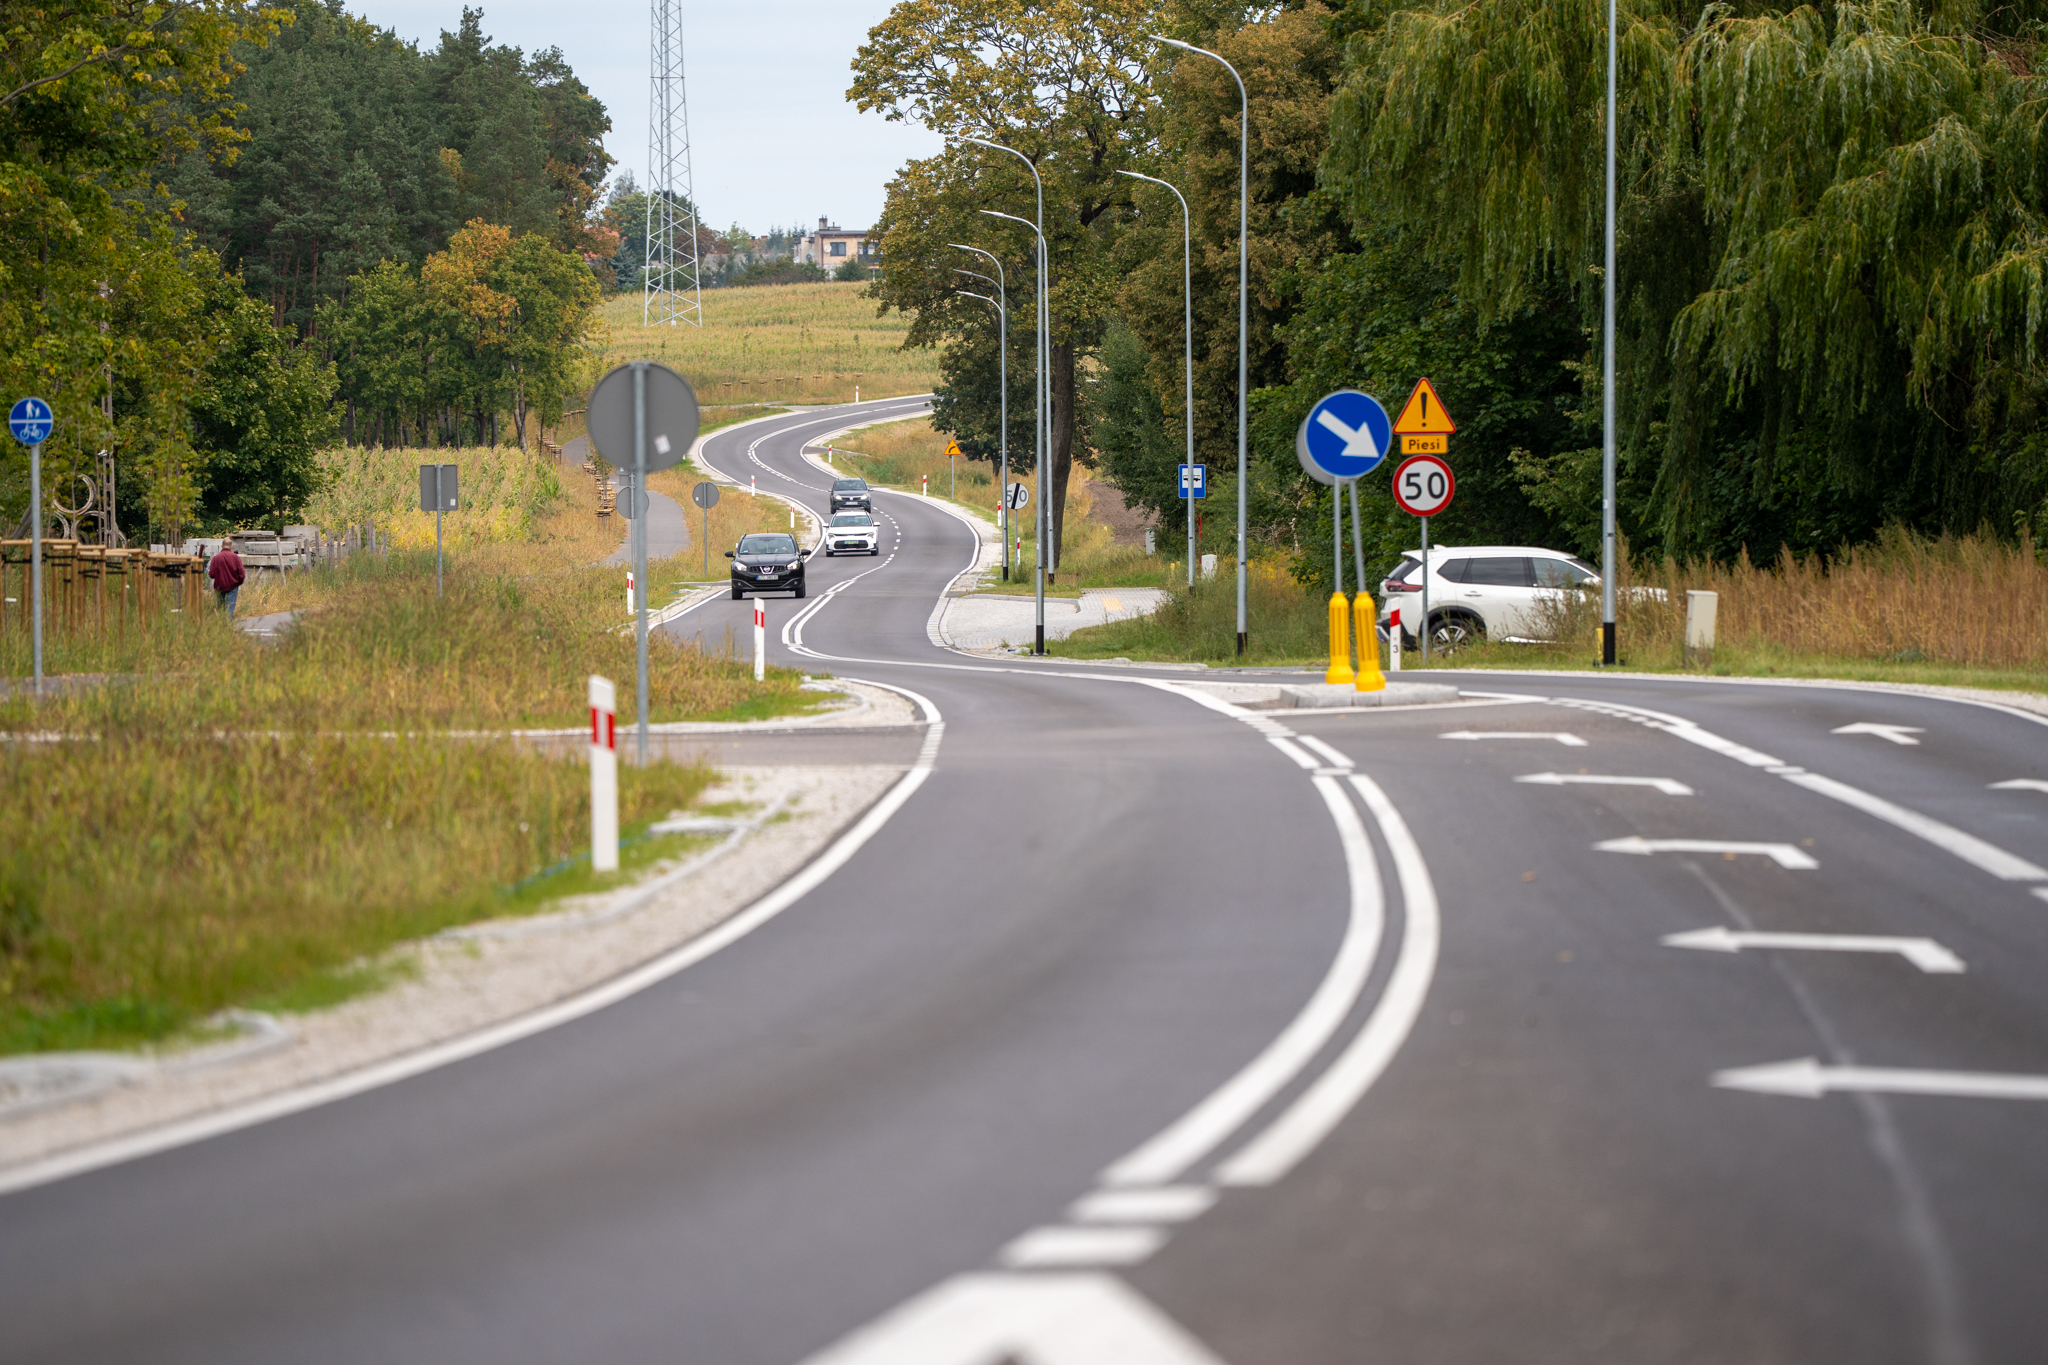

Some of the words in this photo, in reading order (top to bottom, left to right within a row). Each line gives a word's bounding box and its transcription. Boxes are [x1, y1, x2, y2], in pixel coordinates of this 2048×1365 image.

[1408, 438, 1440, 450] Piesi
[1405, 472, 1446, 500] 50
[1007, 490, 1027, 502] 50
[1393, 644, 1398, 653] 3
